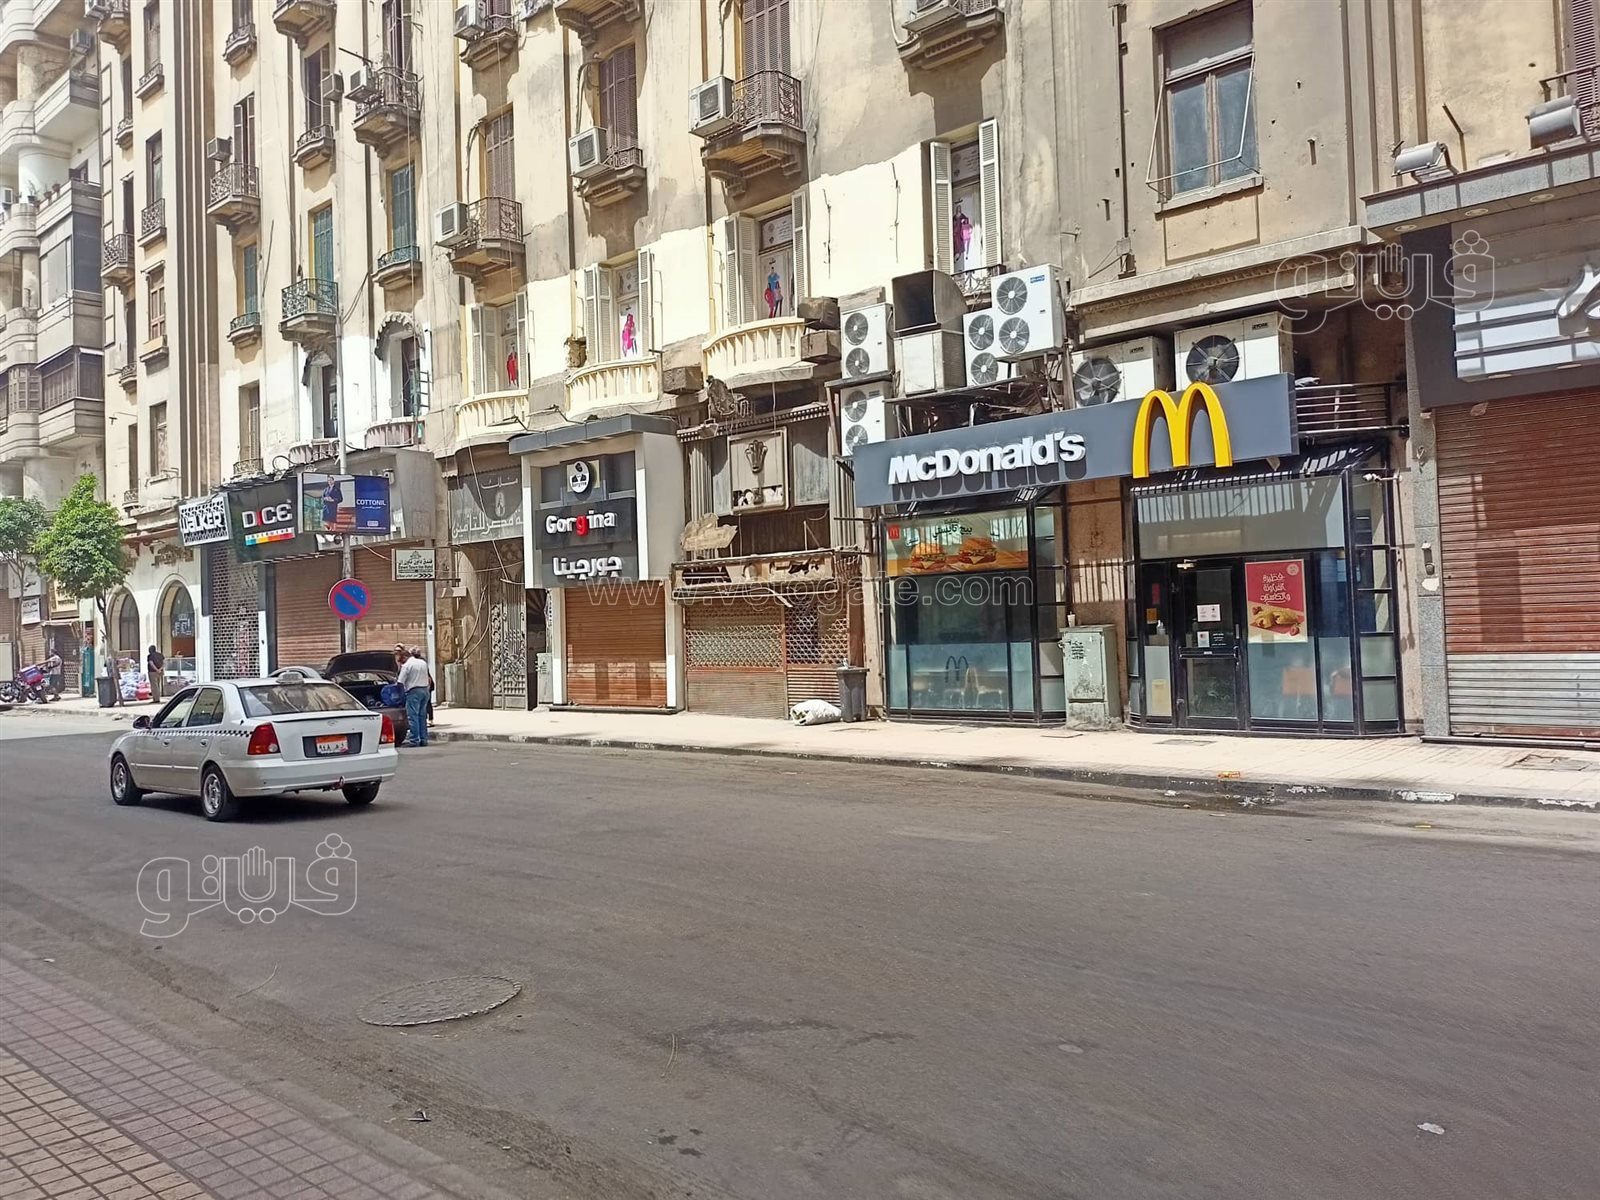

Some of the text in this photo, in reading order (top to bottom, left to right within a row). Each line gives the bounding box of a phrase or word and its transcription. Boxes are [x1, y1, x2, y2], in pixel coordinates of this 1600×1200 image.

[888, 430, 1086, 485] McDonald's
[356, 498, 387, 506] COTTONIL
[241, 504, 293, 529] DICE
[546, 510, 617, 536] Gorgina
[553, 556, 623, 580] جورجينا
